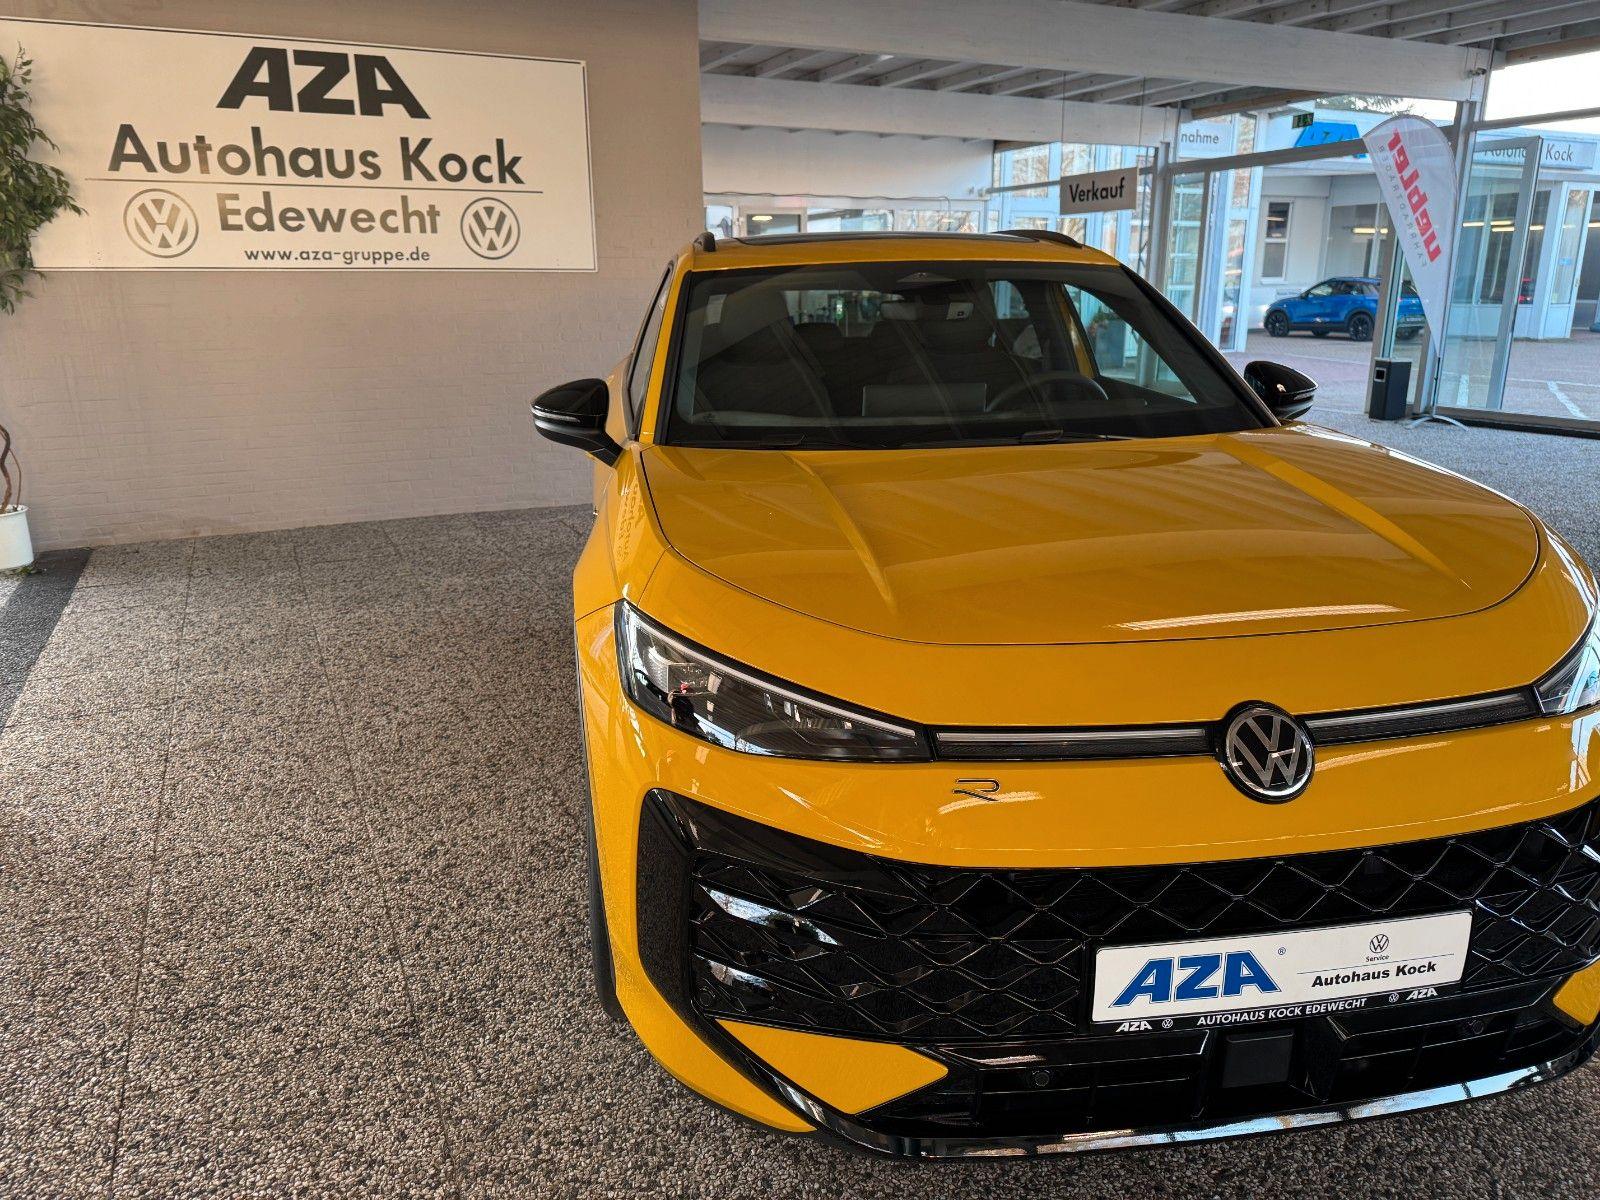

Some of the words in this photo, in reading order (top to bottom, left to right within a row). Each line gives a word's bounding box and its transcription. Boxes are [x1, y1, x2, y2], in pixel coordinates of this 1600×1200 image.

[216, 46, 431, 119] AZA
[108, 124, 382, 180] Autohaus
[400, 137, 525, 184] Kock
[1545, 143, 1573, 162] Kock
[1069, 176, 1125, 203] Verkauf
[217, 191, 441, 234] Edewecht
[244, 247, 430, 265] www.aza-gruppe.de
[1311, 969, 1390, 988] Autohaus
[1395, 961, 1437, 977] Kock
[1365, 954, 1390, 963] Service
[1108, 950, 1282, 1009] AZA
[1115, 1019, 1153, 1033] AZA
[1197, 1010, 1266, 1027] AUTOHAUS
[1268, 1005, 1303, 1020] KOCK
[1305, 998, 1368, 1015] EDEWECHT
[1405, 987, 1439, 1001] AZA
